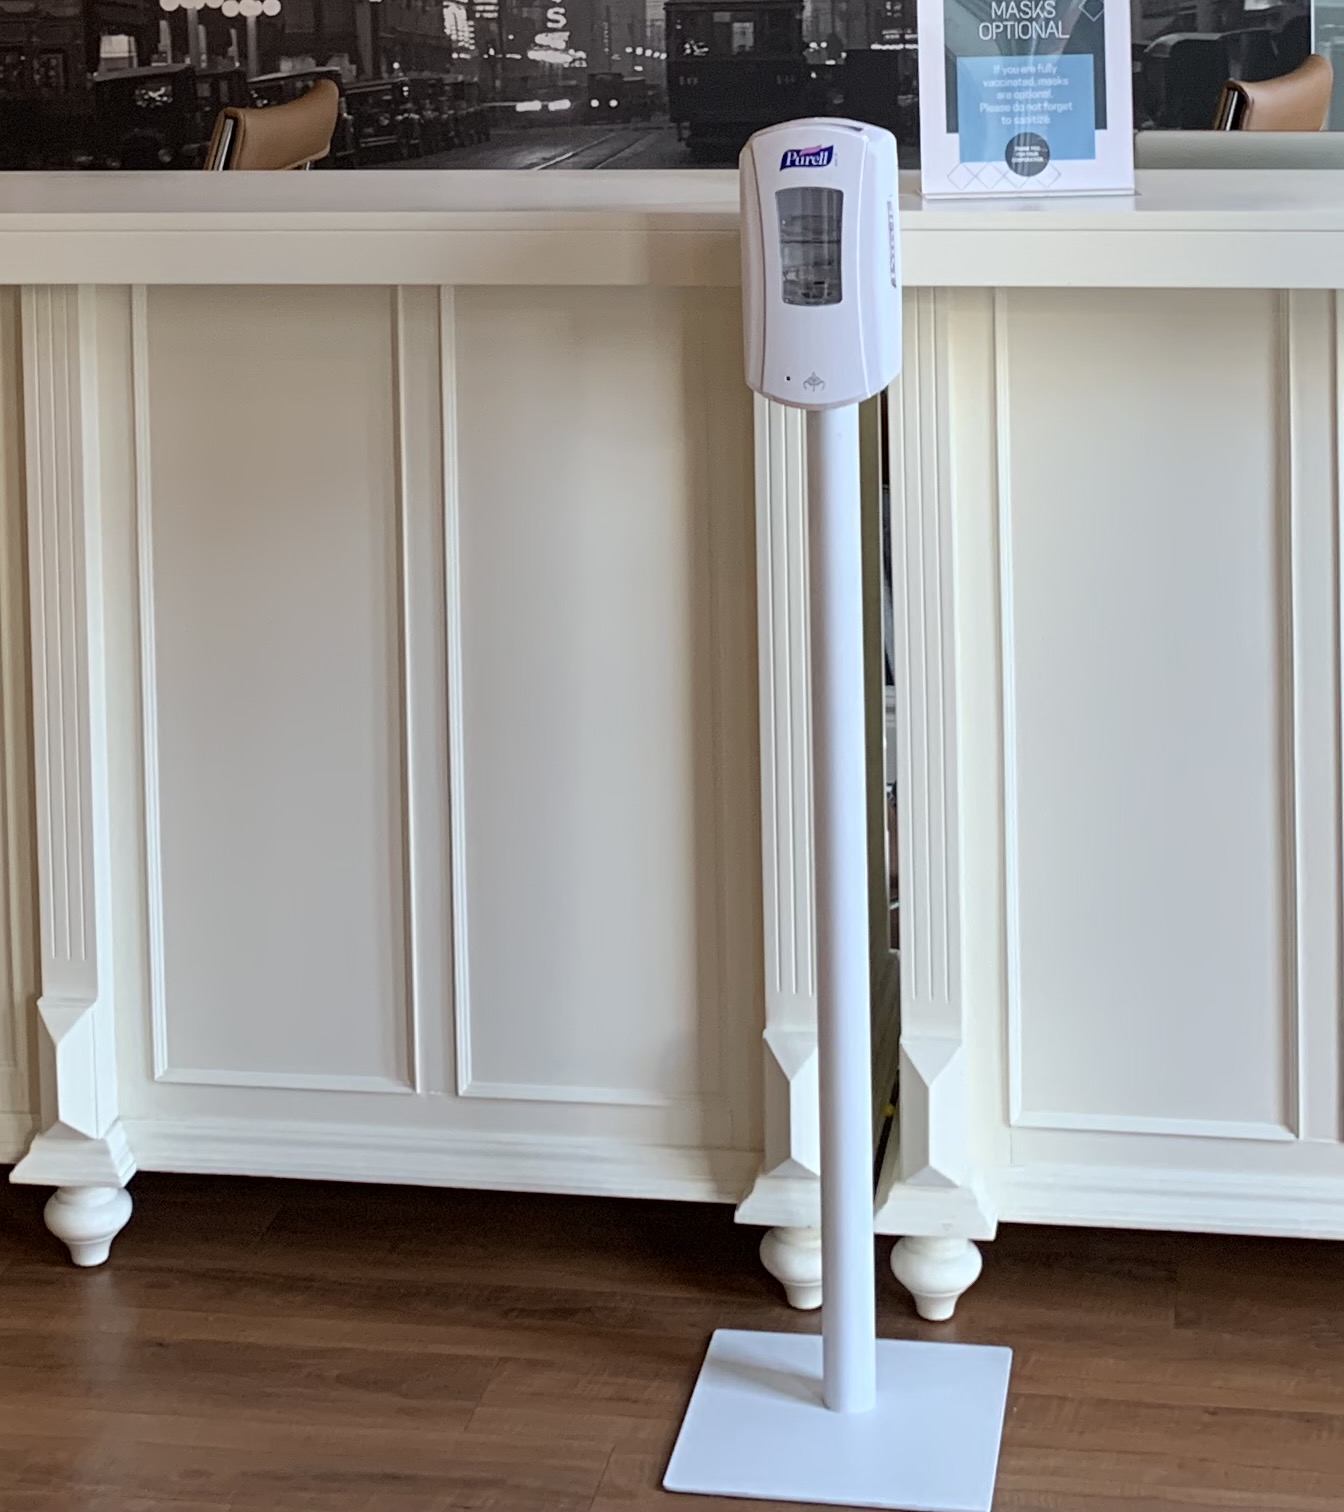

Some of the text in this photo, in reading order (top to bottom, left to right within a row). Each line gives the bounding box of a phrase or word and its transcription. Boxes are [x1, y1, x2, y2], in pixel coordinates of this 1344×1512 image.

[991, 0, 1056, 20] MASKS
[978, 19, 1070, 41] OPTIONAL
[1001, 65, 1020, 76] you
[1020, 64, 1036, 74] are
[1037, 63, 1058, 75] fully
[1037, 76, 1069, 86] masks
[979, 102, 1011, 113] Please
[1043, 102, 1073, 113] forget
[1001, 115, 1012, 125] to
